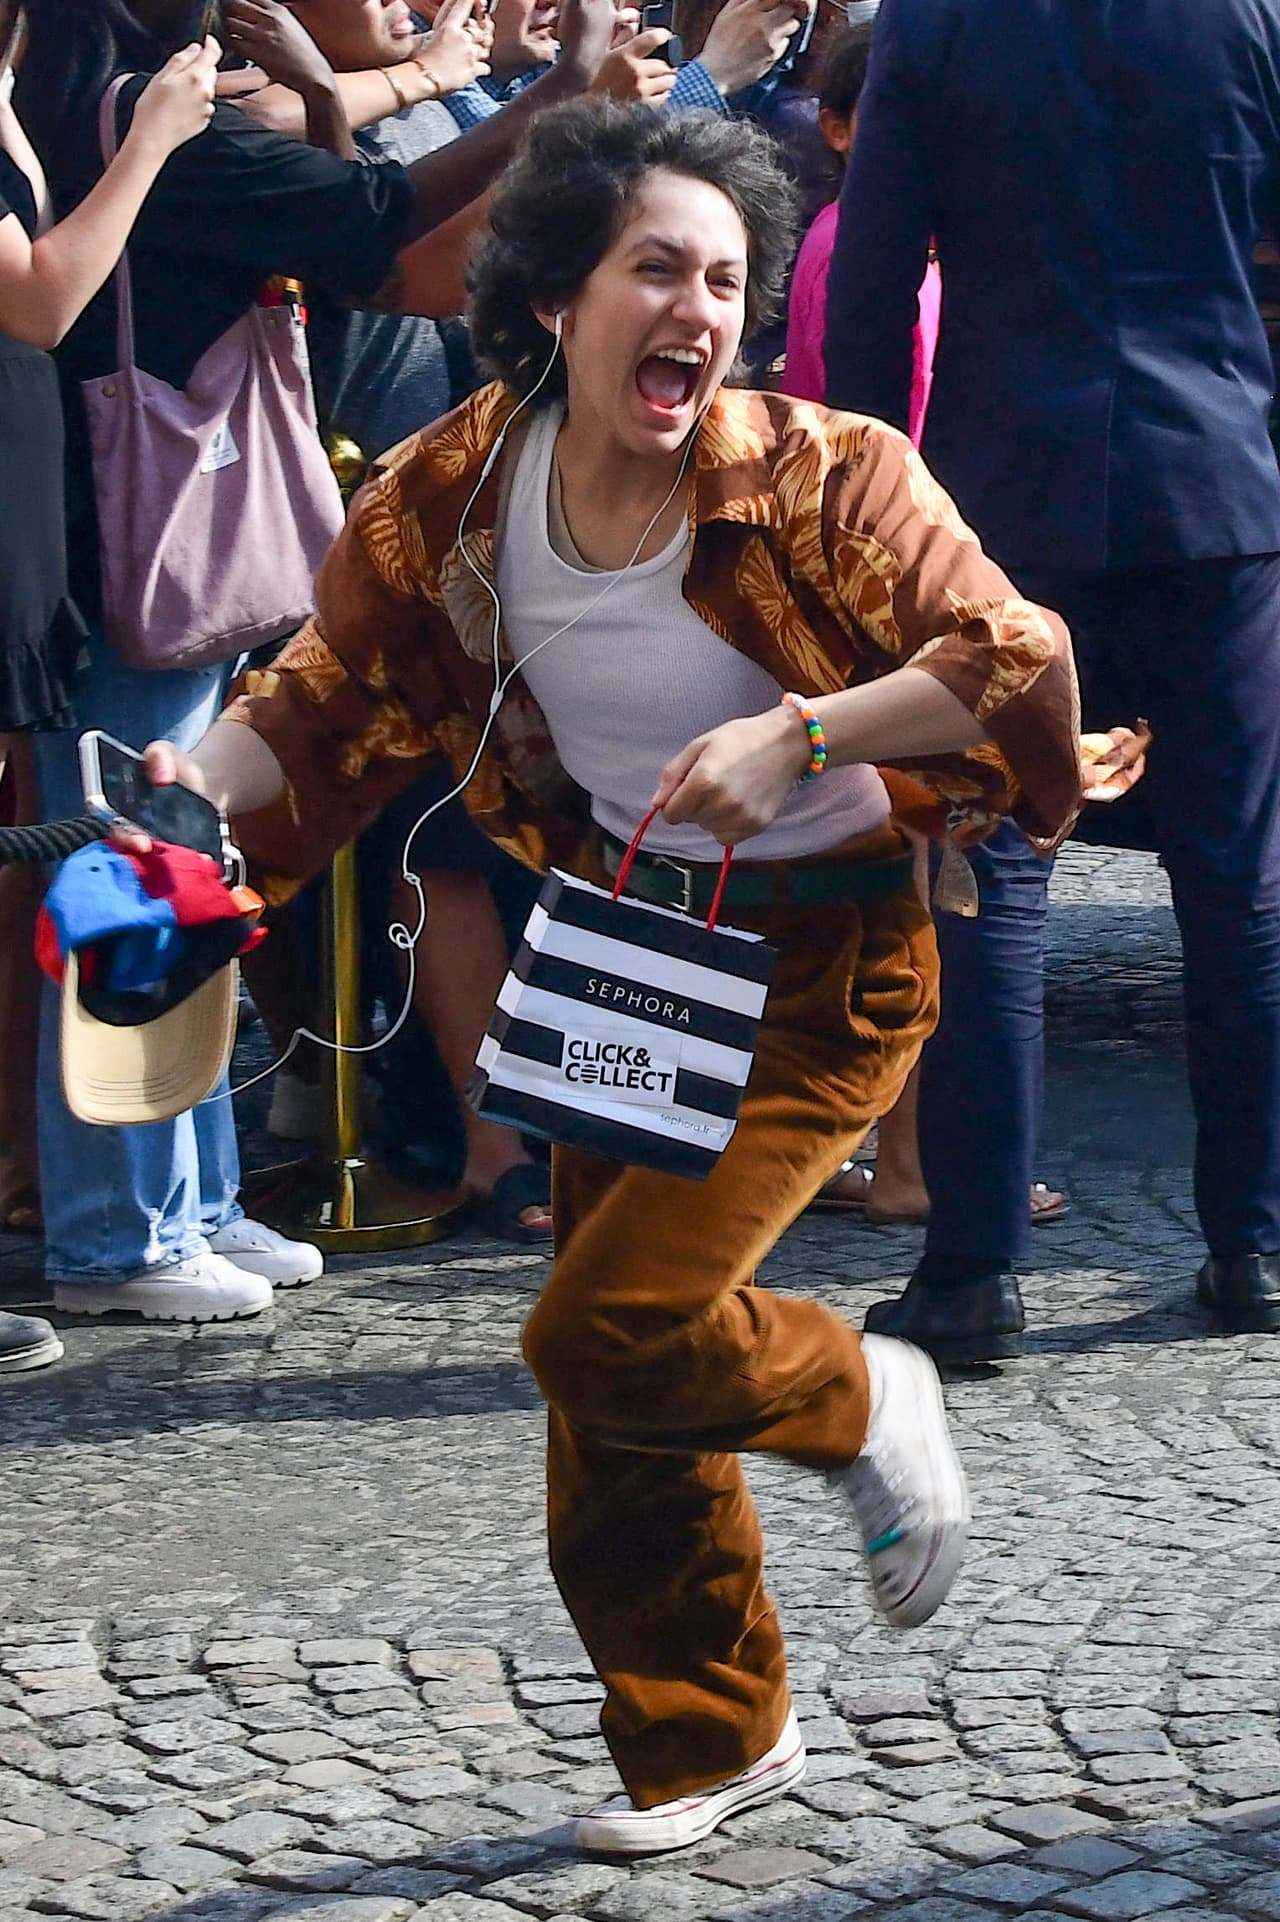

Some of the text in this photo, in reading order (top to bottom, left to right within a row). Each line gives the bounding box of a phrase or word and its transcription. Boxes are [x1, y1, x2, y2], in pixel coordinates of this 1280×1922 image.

[585, 978, 690, 1024] SEPHORA
[567, 1040, 652, 1068] CLICK&
[565, 1062, 673, 1093] COLLECT
[660, 1113, 710, 1135] sephora.fr
